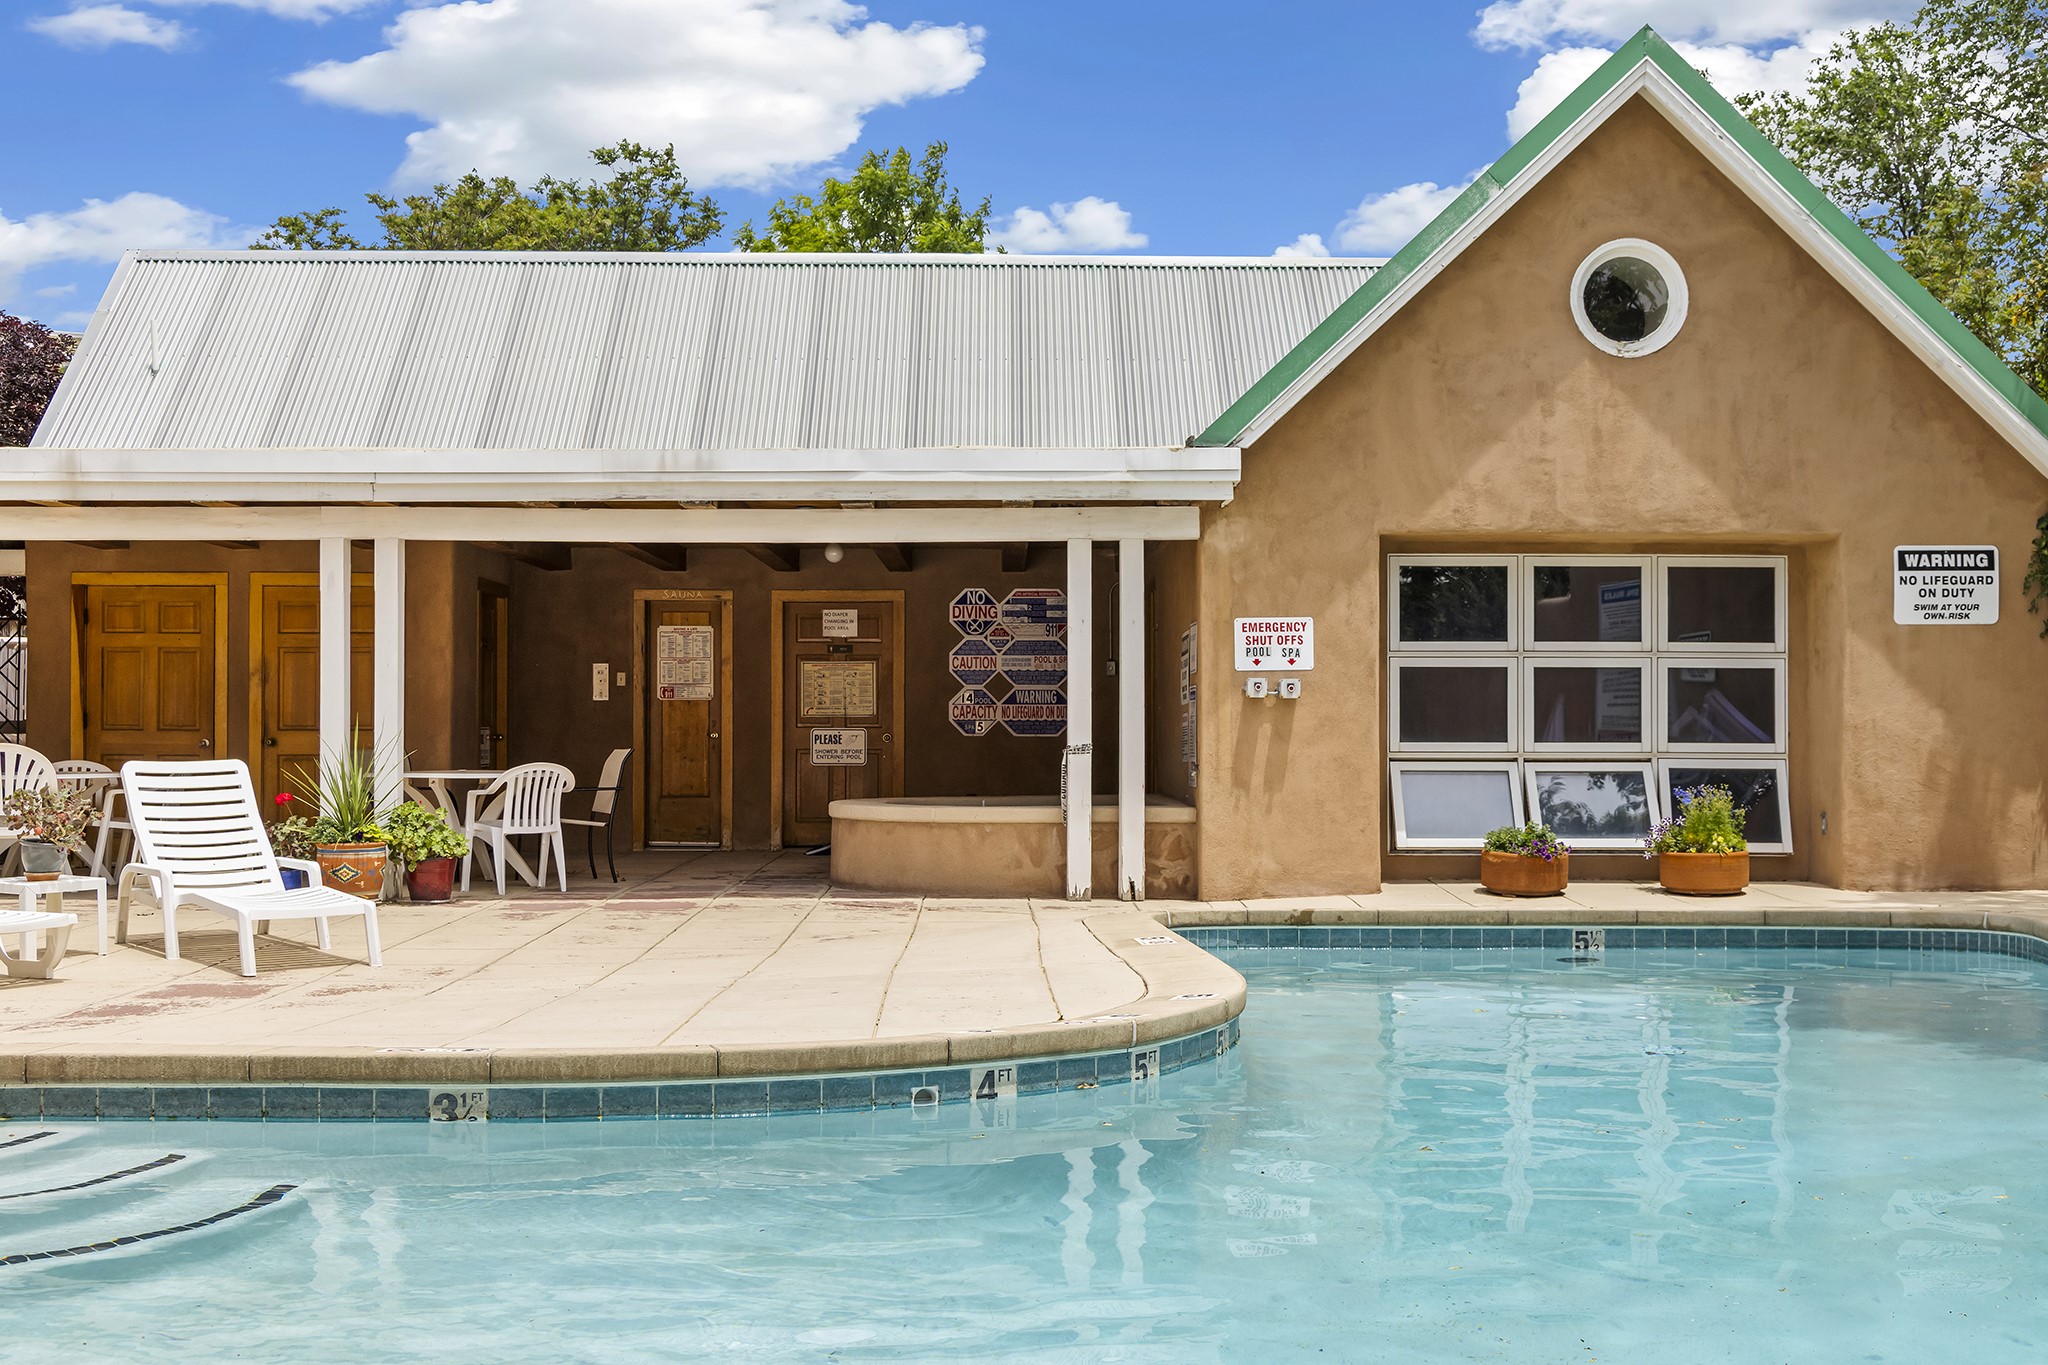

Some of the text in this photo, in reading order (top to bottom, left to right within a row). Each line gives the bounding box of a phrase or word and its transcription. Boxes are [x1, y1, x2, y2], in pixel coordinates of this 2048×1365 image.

[1904, 553, 1988, 567] WARNING
[1899, 575, 1994, 585] NO LIFEGUARD
[662, 590, 704, 599] SAUNA
[967, 591, 985, 605] NO
[1918, 588, 1975, 598] ON DUTY
[952, 605, 998, 619] DIVING
[1923, 612, 1971, 620] OWN RISK
[1045, 624, 1058, 637] 911
[1241, 622, 1307, 632] EMERGENCY
[1245, 635, 1304, 646] SHUT OFFS
[1246, 647, 1271, 657] POOL
[1282, 648, 1301, 658] SPA
[952, 656, 997, 669] CAUTION
[1034, 656, 1052, 664] POOL
[1059, 656, 1067, 664] SP
[961, 693, 973, 704] 14
[1015, 690, 1057, 704] WARNING
[952, 705, 998, 719] CAPACITY
[1001, 705, 1067, 719] NO LIFEGUARD ON DUT
[977, 721, 984, 732] 5
[814, 733, 843, 745] PLEASE
[1134, 1050, 1157, 1080] 5 FT
[975, 1068, 1013, 1100] 4 FT
[471, 1092, 484, 1101] FT
